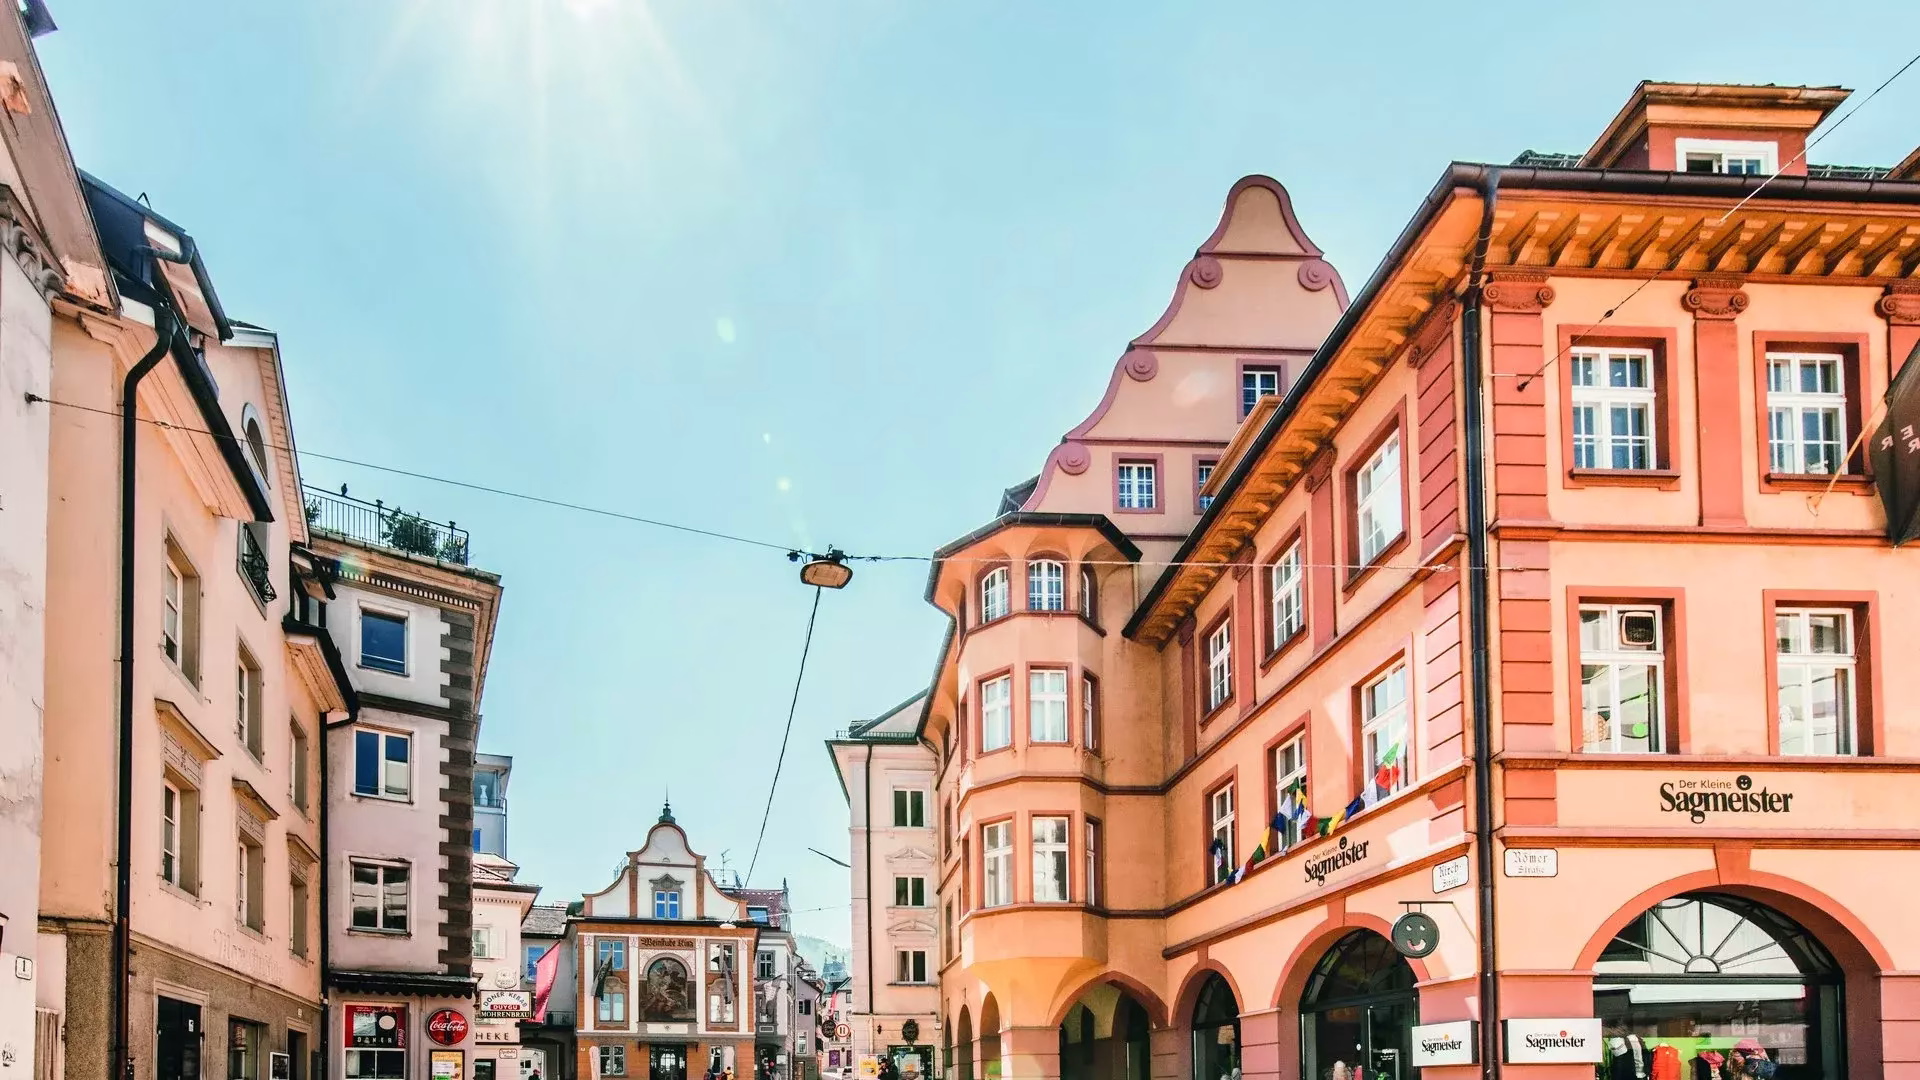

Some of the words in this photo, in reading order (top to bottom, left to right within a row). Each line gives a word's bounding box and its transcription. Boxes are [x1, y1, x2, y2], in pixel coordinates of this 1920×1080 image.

[1679, 780, 1697, 789] Der
[1700, 780, 1732, 789] Kleine
[1659, 781, 1793, 824] Sagmeister
[1305, 840, 1369, 886] Sagmeister
[1513, 851, 1548, 863] Römer
[1421, 1039, 1462, 1057] Sagmeister
[1525, 1034, 1586, 1053] Sagmeister
